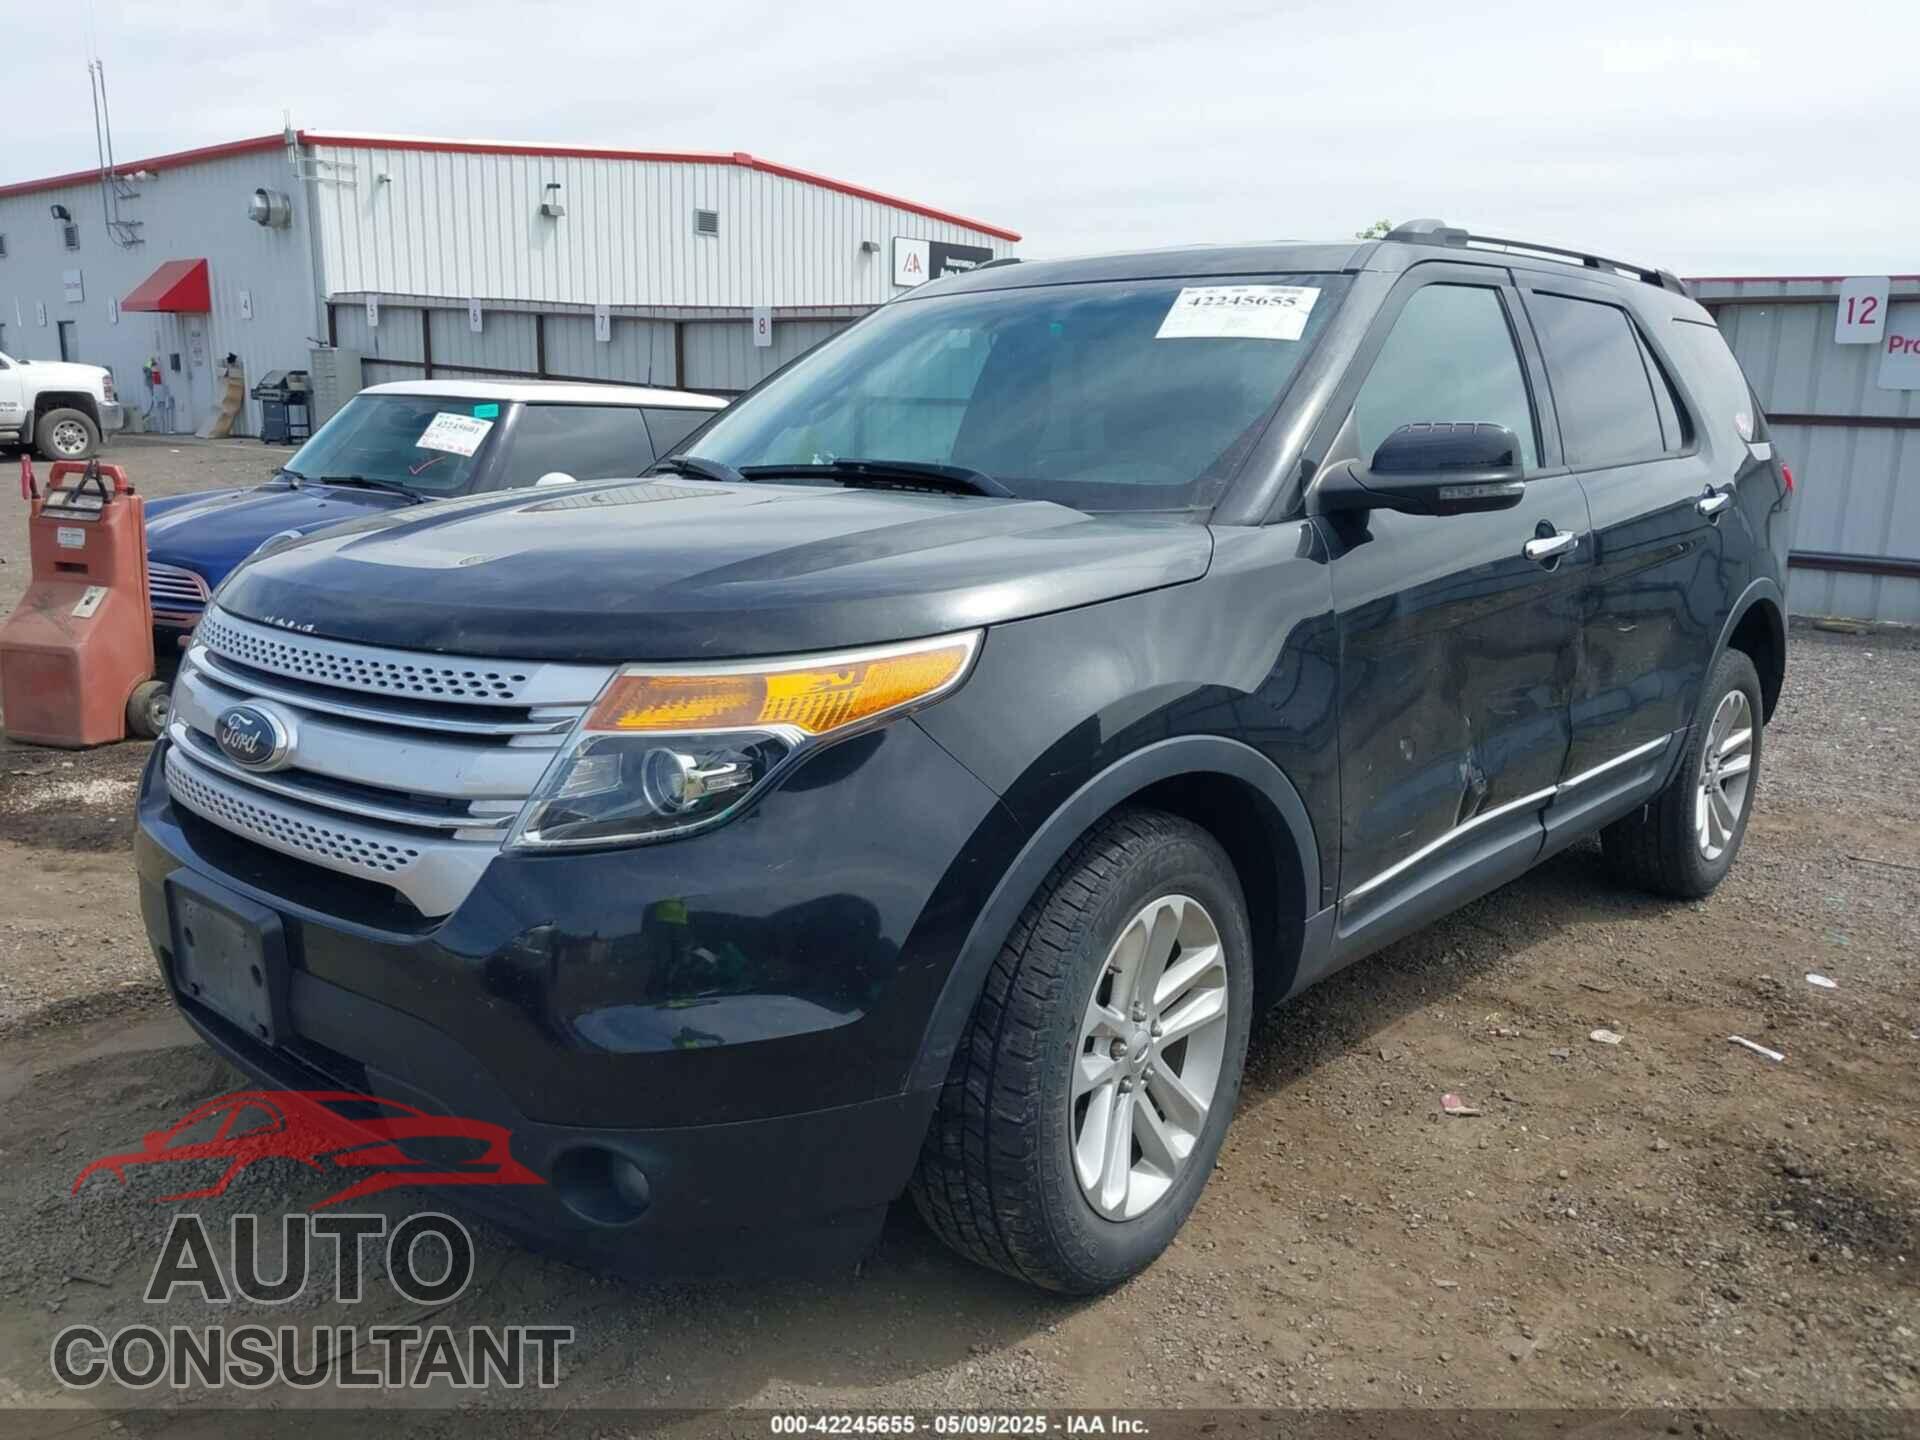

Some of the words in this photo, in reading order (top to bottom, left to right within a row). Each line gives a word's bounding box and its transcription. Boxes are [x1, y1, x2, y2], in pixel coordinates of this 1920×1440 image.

[1188, 296, 1297, 308] 42245655
[1847, 296, 1878, 325] 12
[599, 315, 606, 332] 7
[759, 317, 766, 335] 8
[222, 712, 262, 754] Ford
